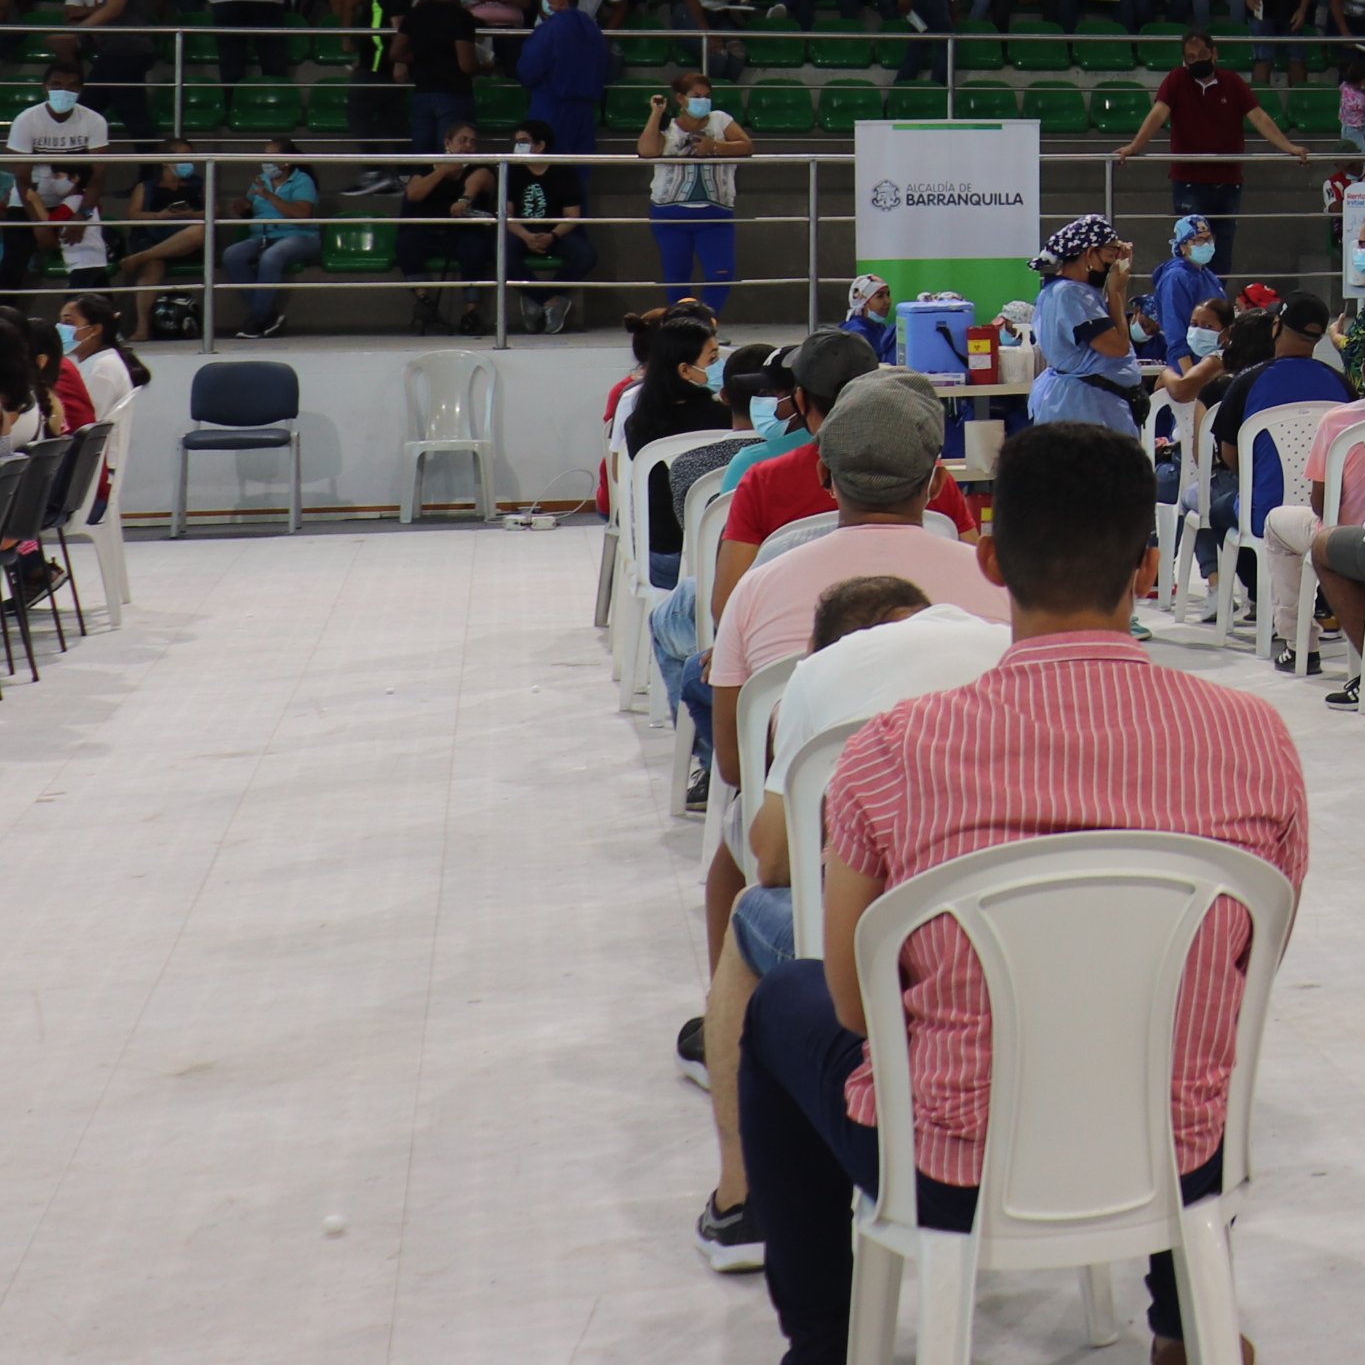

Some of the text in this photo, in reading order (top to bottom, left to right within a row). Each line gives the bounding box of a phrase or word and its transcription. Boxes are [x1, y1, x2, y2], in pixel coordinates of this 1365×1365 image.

[905, 181, 972, 193] ALCALDÍA DE
[905, 193, 1024, 206] BARRANQUILLA
